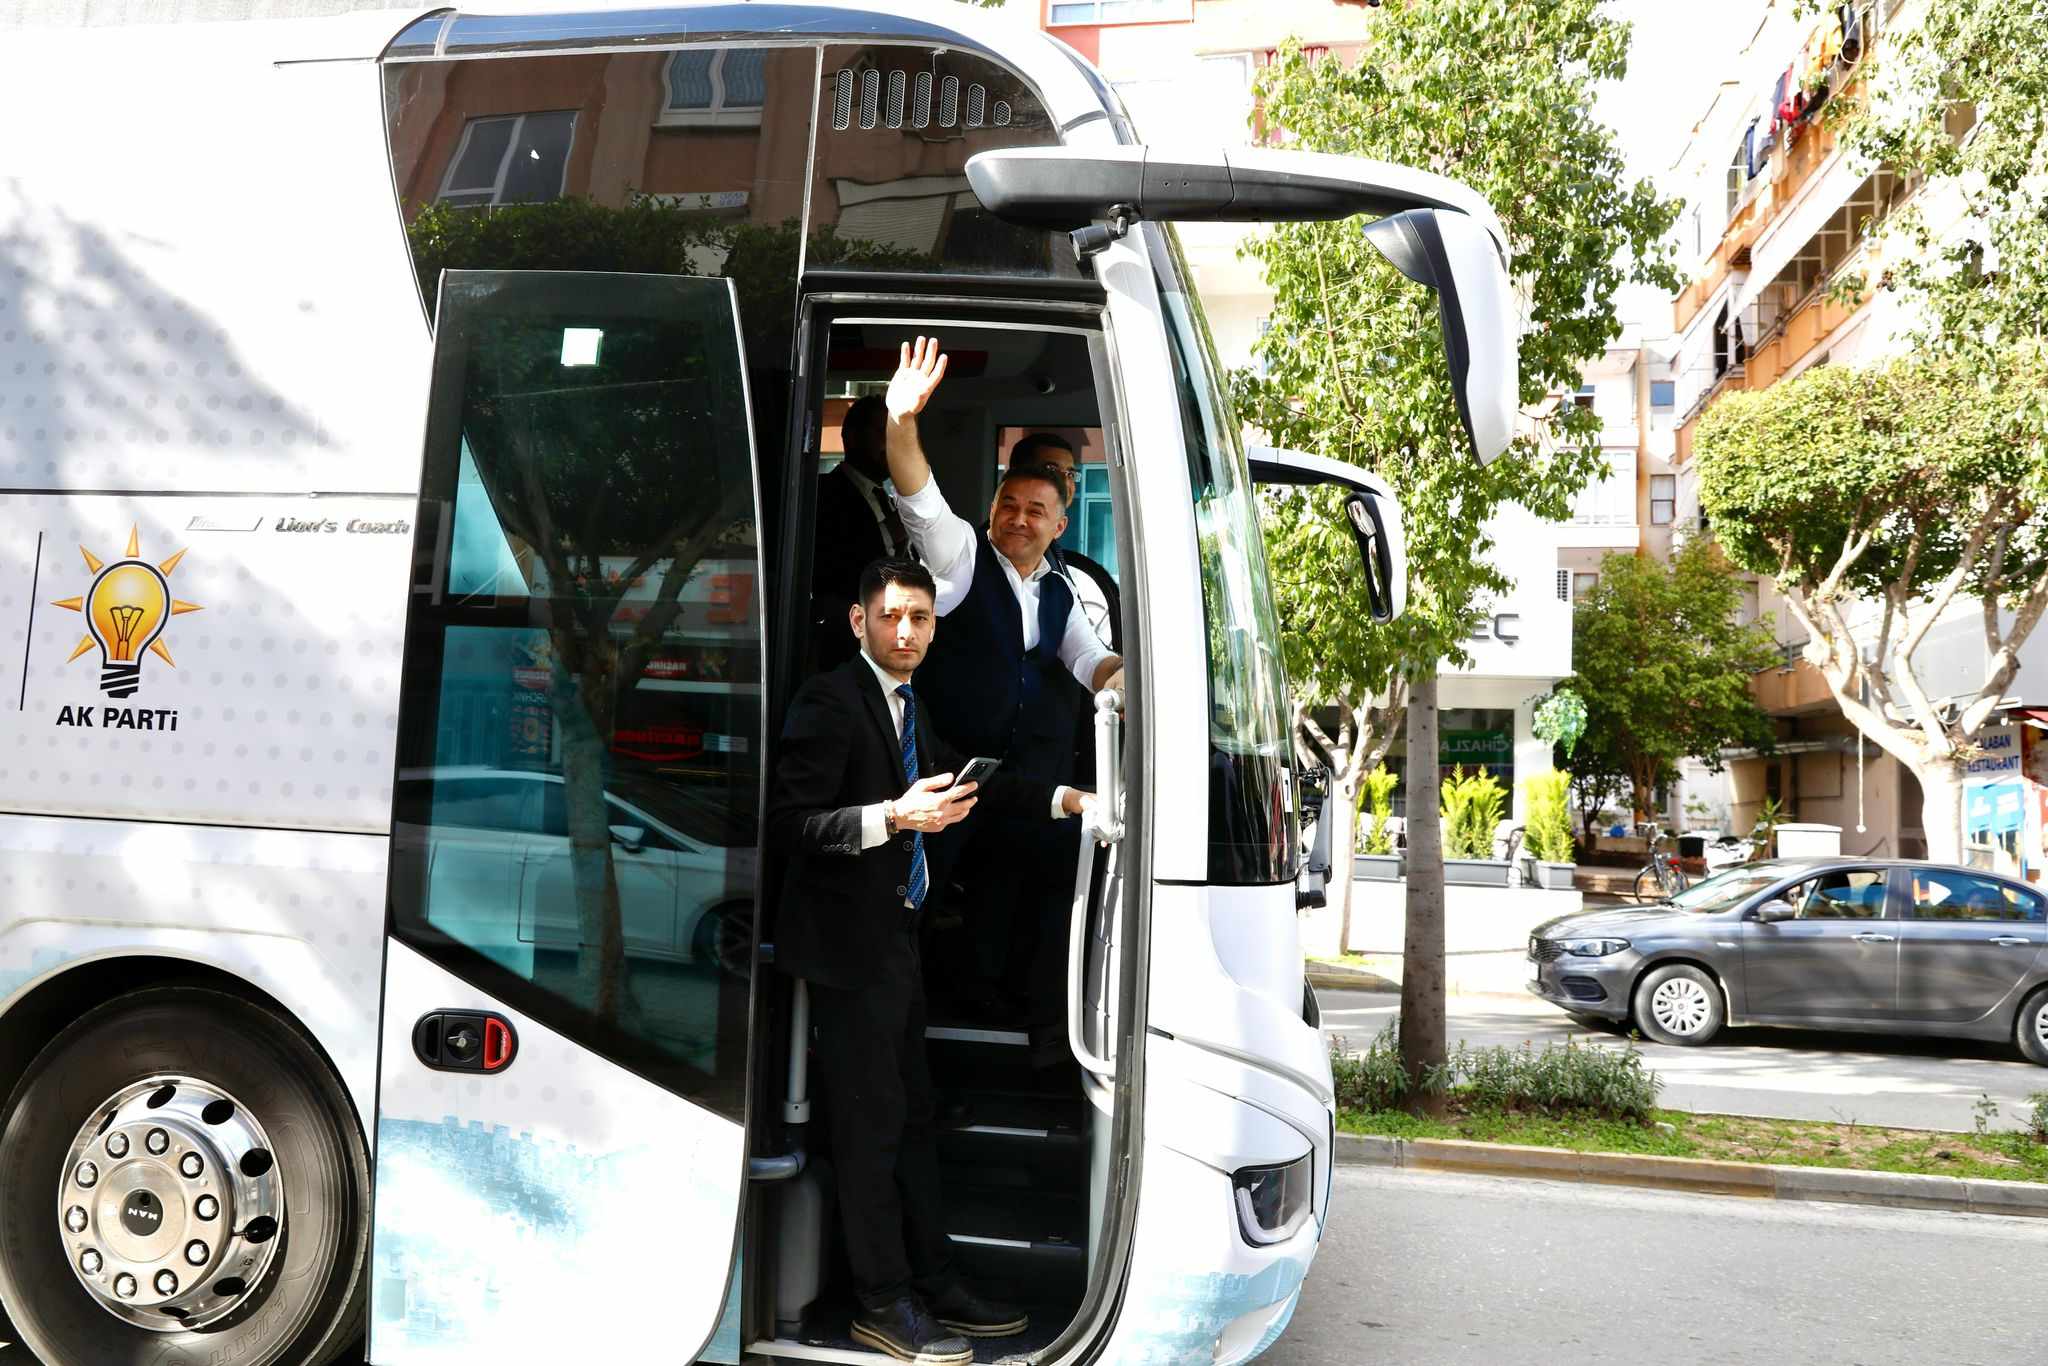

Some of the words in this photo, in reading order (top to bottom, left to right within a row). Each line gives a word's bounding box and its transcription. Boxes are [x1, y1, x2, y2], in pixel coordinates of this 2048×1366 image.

[275, 516, 338, 533] Lion's
[346, 518, 411, 534] Coach
[56, 705, 95, 727] AK
[128, 1207, 158, 1221] MAN
